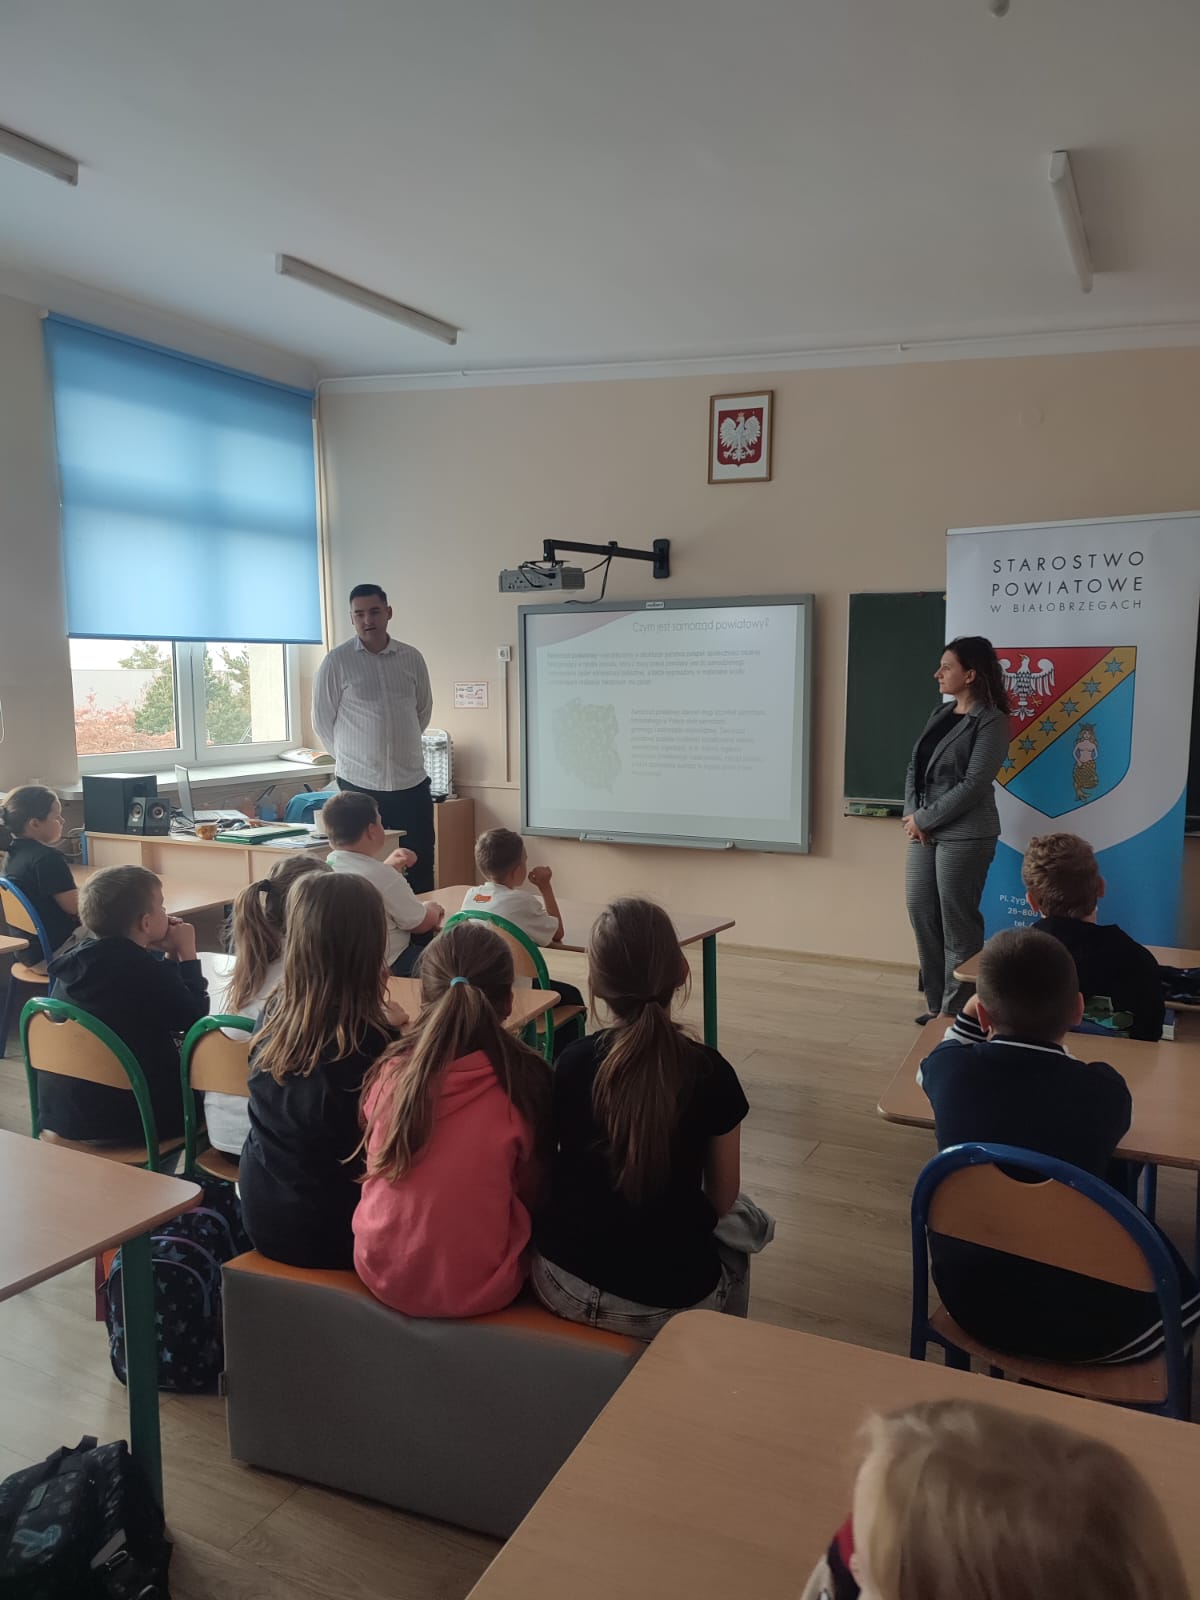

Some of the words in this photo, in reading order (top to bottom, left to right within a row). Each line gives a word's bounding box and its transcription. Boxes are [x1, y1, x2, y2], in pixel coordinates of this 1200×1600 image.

[993, 551, 1144, 574] STAROSTWO
[992, 576, 1143, 597] POWIATOWE
[990, 604, 1002, 614] W
[1013, 600, 1142, 613] BIAŁOBRZEGACH
